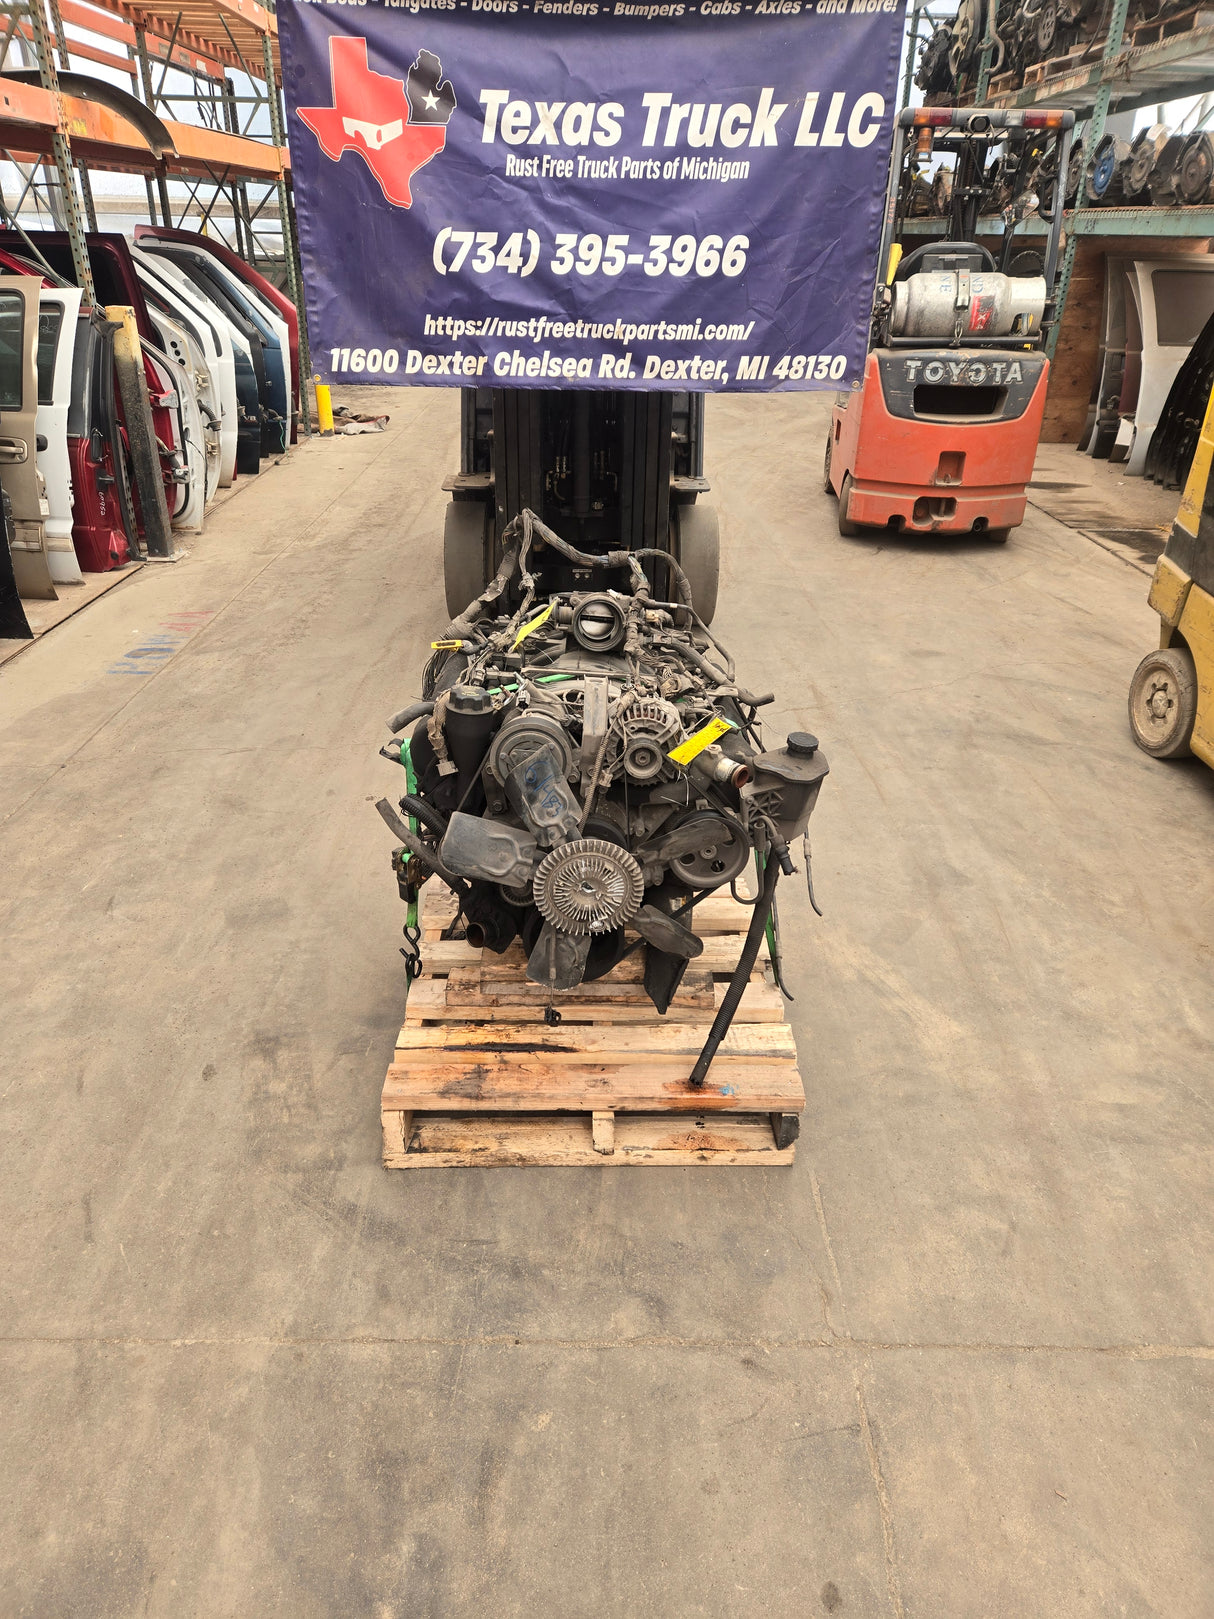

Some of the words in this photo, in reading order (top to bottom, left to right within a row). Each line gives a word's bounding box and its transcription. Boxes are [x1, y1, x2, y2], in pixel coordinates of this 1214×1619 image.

[471, 0, 518, 13] Doors
[534, 1, 599, 15] Fenders
[613, 2, 685, 19] Bumpers
[700, 0, 741, 15] Cabs
[755, 0, 801, 14] Axles
[850, 0, 897, 14] More!
[479, 88, 625, 147] Texas
[642, 87, 790, 148] Truck
[793, 91, 886, 149] LLC
[505, 154, 540, 178] Rust
[541, 155, 574, 178] Free
[576, 155, 618, 179] Truck
[620, 156, 661, 180] Parts
[662, 157, 680, 179] of
[680, 157, 751, 183] Michigan
[432, 227, 541, 278] (734)
[550, 232, 750, 278] 395-3966
[423, 313, 755, 345] https://rustfreetruckpartsmi.com/
[329, 347, 400, 374] 11600
[405, 349, 488, 376] Dexter
[493, 349, 594, 378] Chelsea
[598, 352, 636, 380] Rd.
[642, 354, 728, 384] Dexter,
[735, 355, 770, 380] MI
[771, 354, 848, 381] 48130
[905, 359, 1023, 384] TOYOTA
